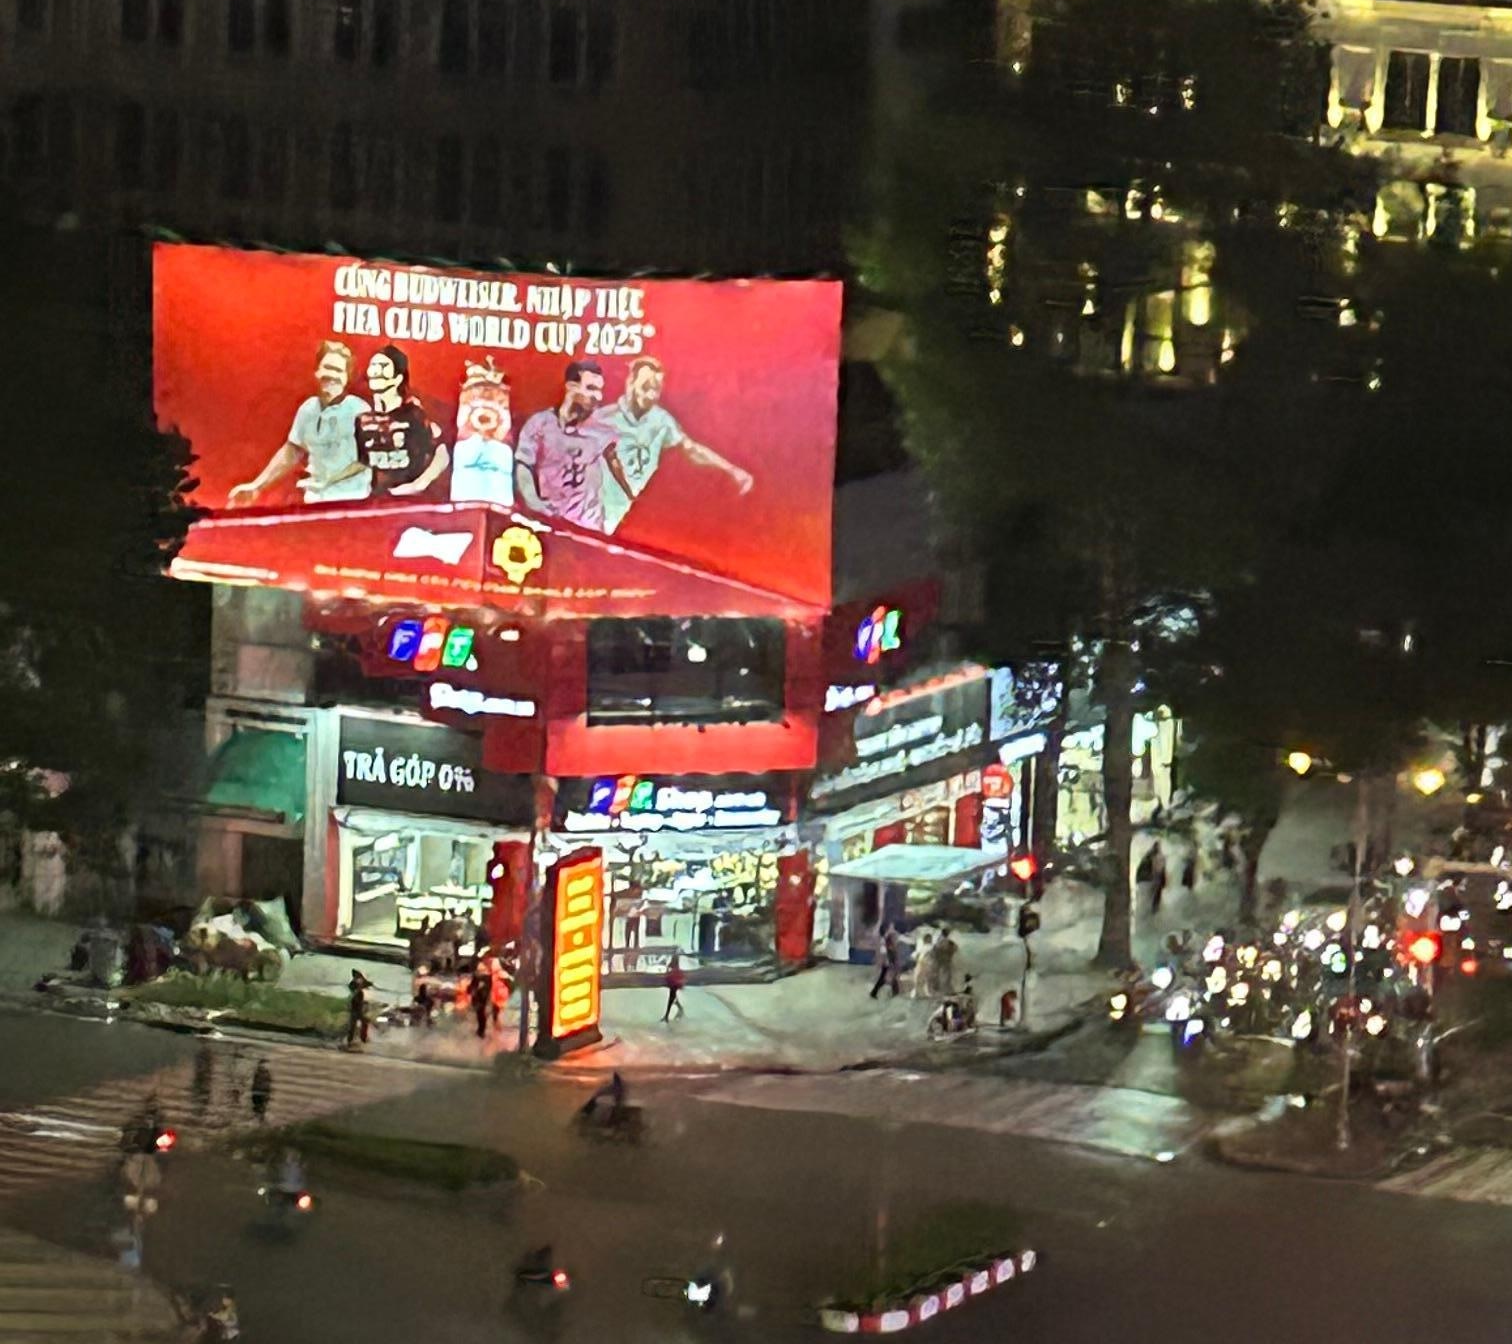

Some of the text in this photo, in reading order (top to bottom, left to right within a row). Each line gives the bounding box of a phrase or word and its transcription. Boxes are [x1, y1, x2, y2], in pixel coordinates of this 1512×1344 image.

[332, 300, 380, 336] FIFA
[385, 307, 445, 343] CLUB
[448, 312, 531, 351] WORLD
[534, 321, 582, 356] CUP
[388, 613, 479, 671] FPT
[389, 752, 436, 789] GÓP
